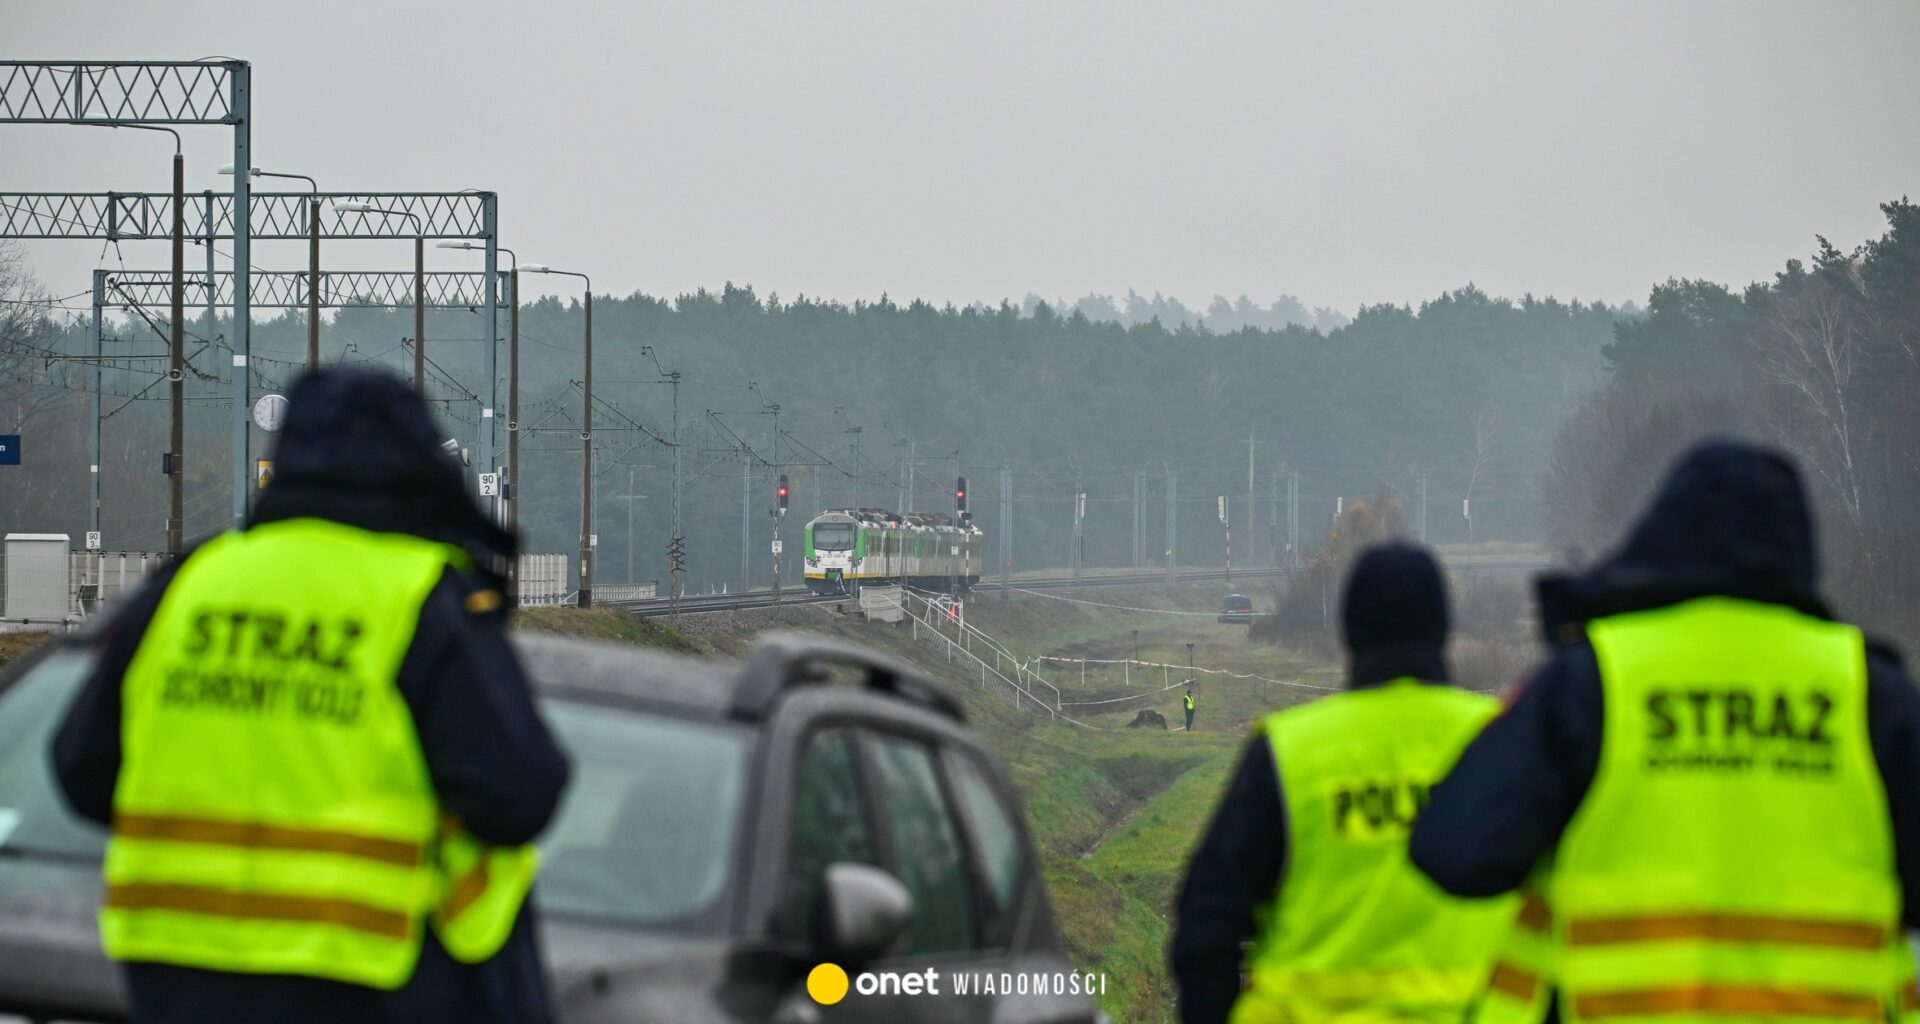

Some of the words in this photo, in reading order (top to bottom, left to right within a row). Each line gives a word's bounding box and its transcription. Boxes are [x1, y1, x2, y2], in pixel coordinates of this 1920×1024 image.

[482, 475, 494, 484] 90
[484, 485, 490, 494] 2
[88, 532, 98, 540] 90
